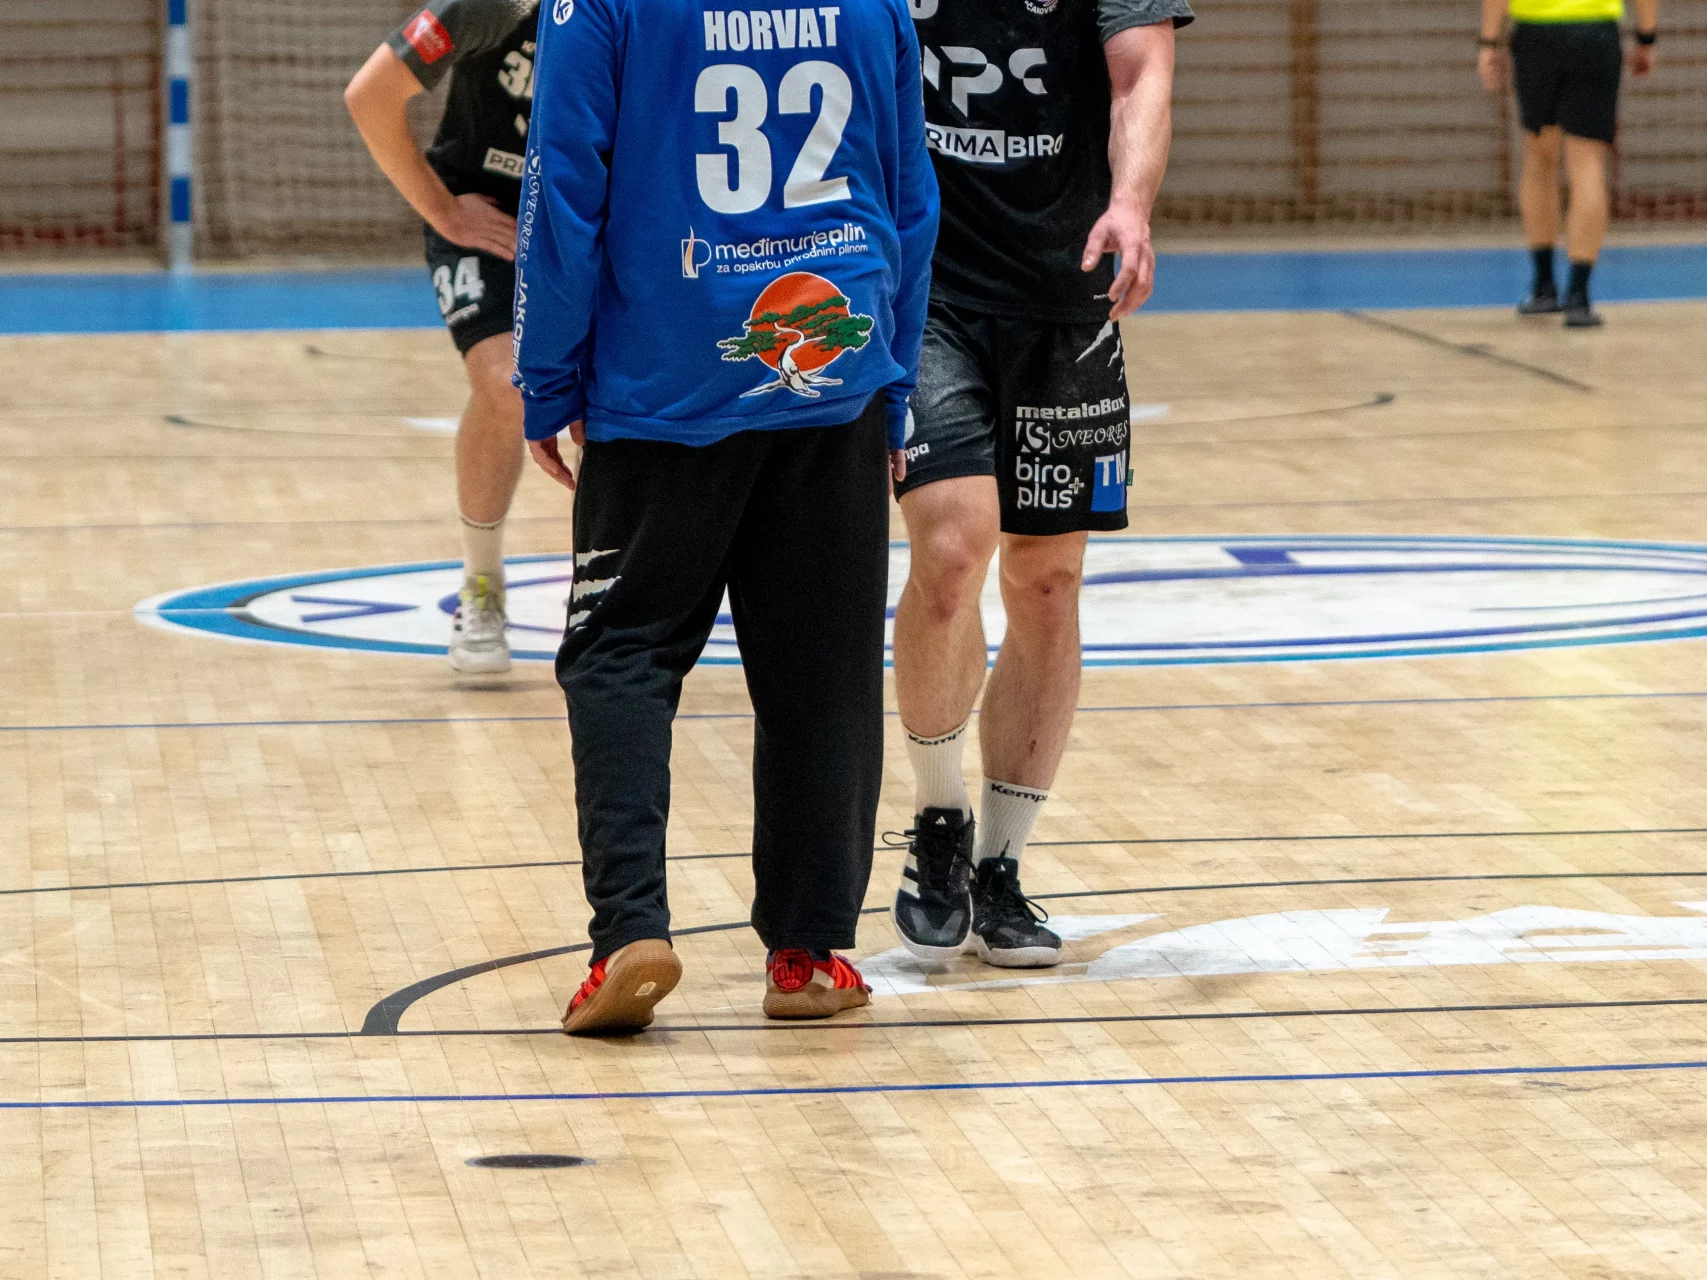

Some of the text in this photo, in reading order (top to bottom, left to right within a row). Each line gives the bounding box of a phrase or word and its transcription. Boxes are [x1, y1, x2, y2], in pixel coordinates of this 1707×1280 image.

[703, 6, 841, 52] HORVAT
[497, 49, 535, 99] 3
[694, 59, 853, 215] 32
[715, 223, 867, 261] međimurjeplin
[716, 263, 731, 274] za
[733, 258, 782, 275] opskrbu
[838, 242, 869, 257] plinom
[433, 255, 486, 315] 34
[1016, 397, 1126, 420] metaloBox
[1015, 455, 1071, 484] biro
